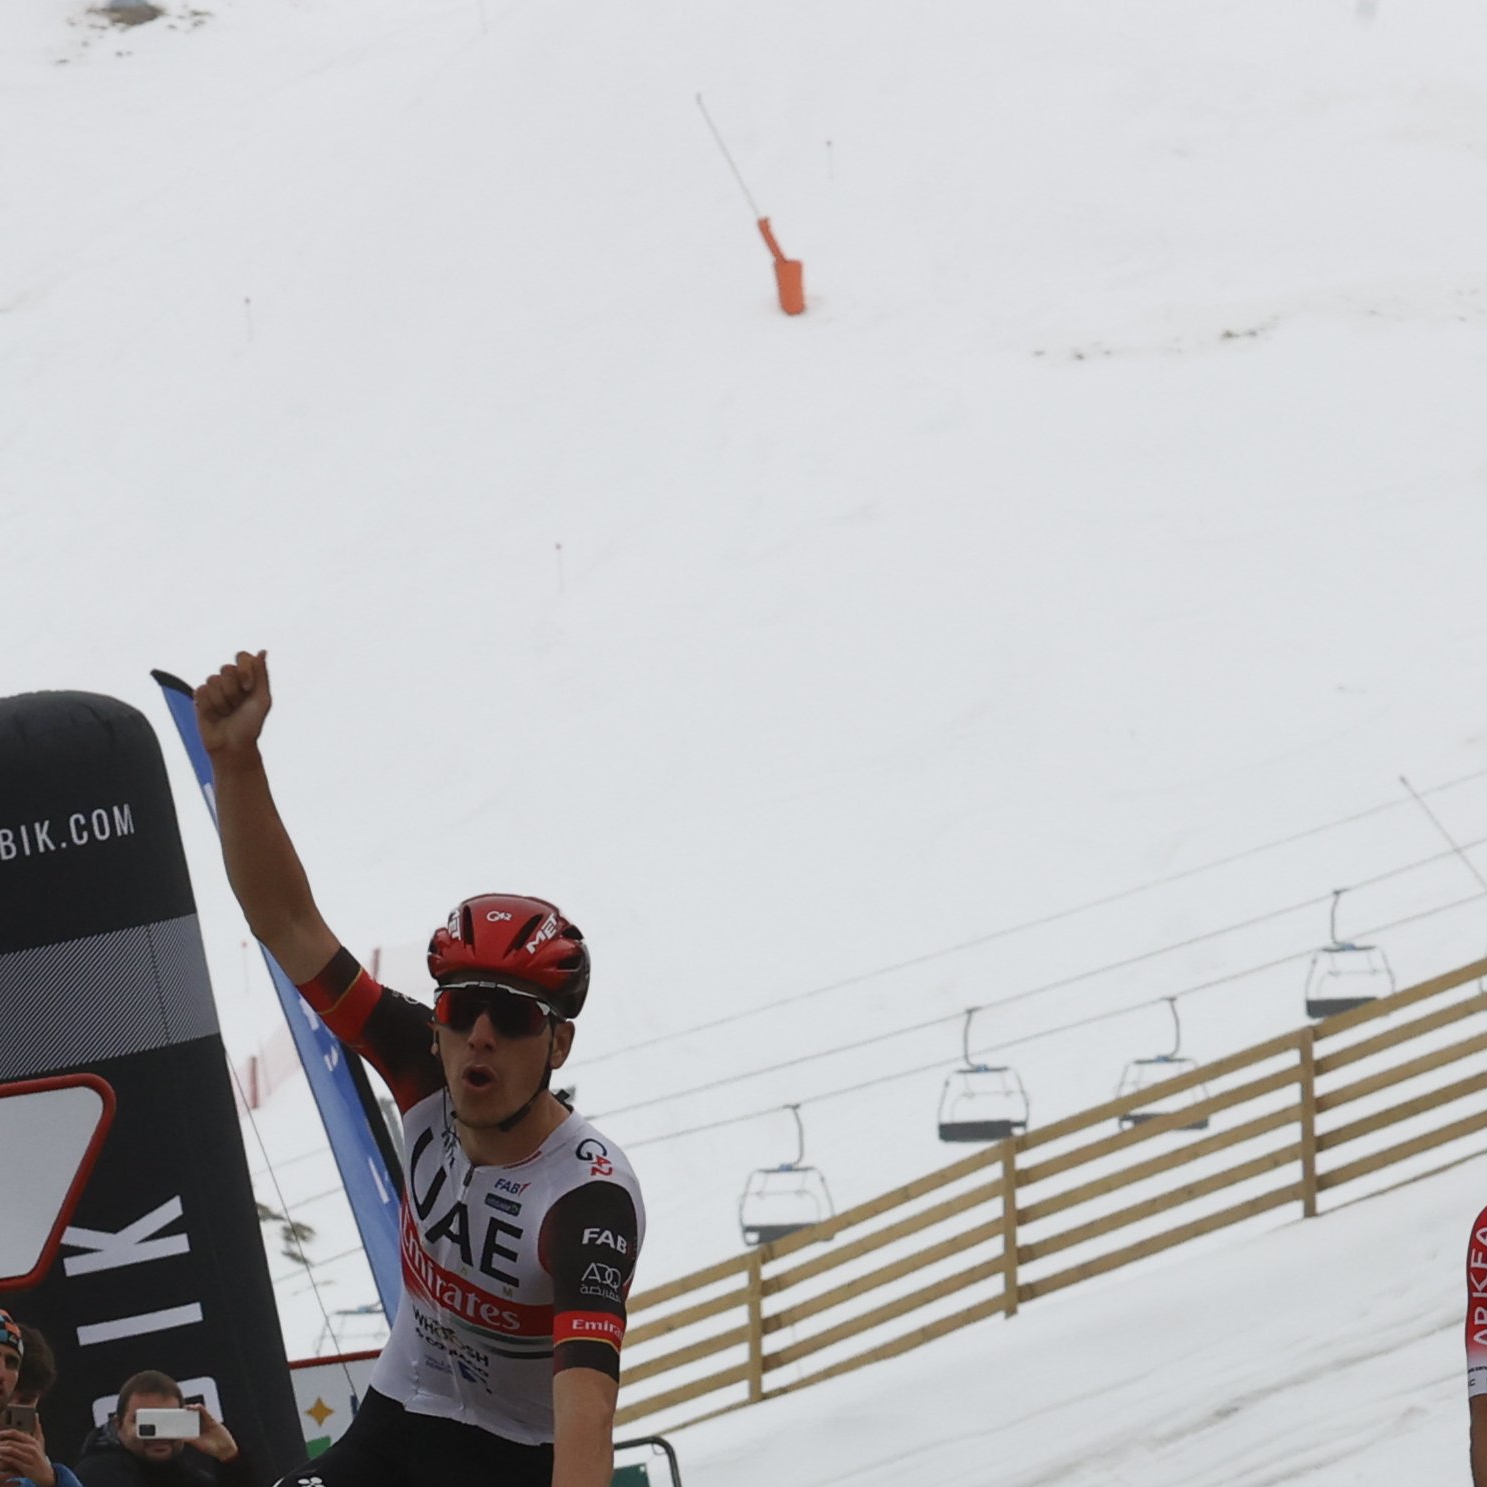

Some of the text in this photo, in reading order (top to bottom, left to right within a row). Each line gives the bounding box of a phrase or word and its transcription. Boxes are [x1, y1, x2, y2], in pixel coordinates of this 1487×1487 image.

[525, 912, 559, 955] MET
[411, 1127, 524, 1288] UAE
[582, 1227, 627, 1255] FAB
[581, 1262, 622, 1292] ADQ
